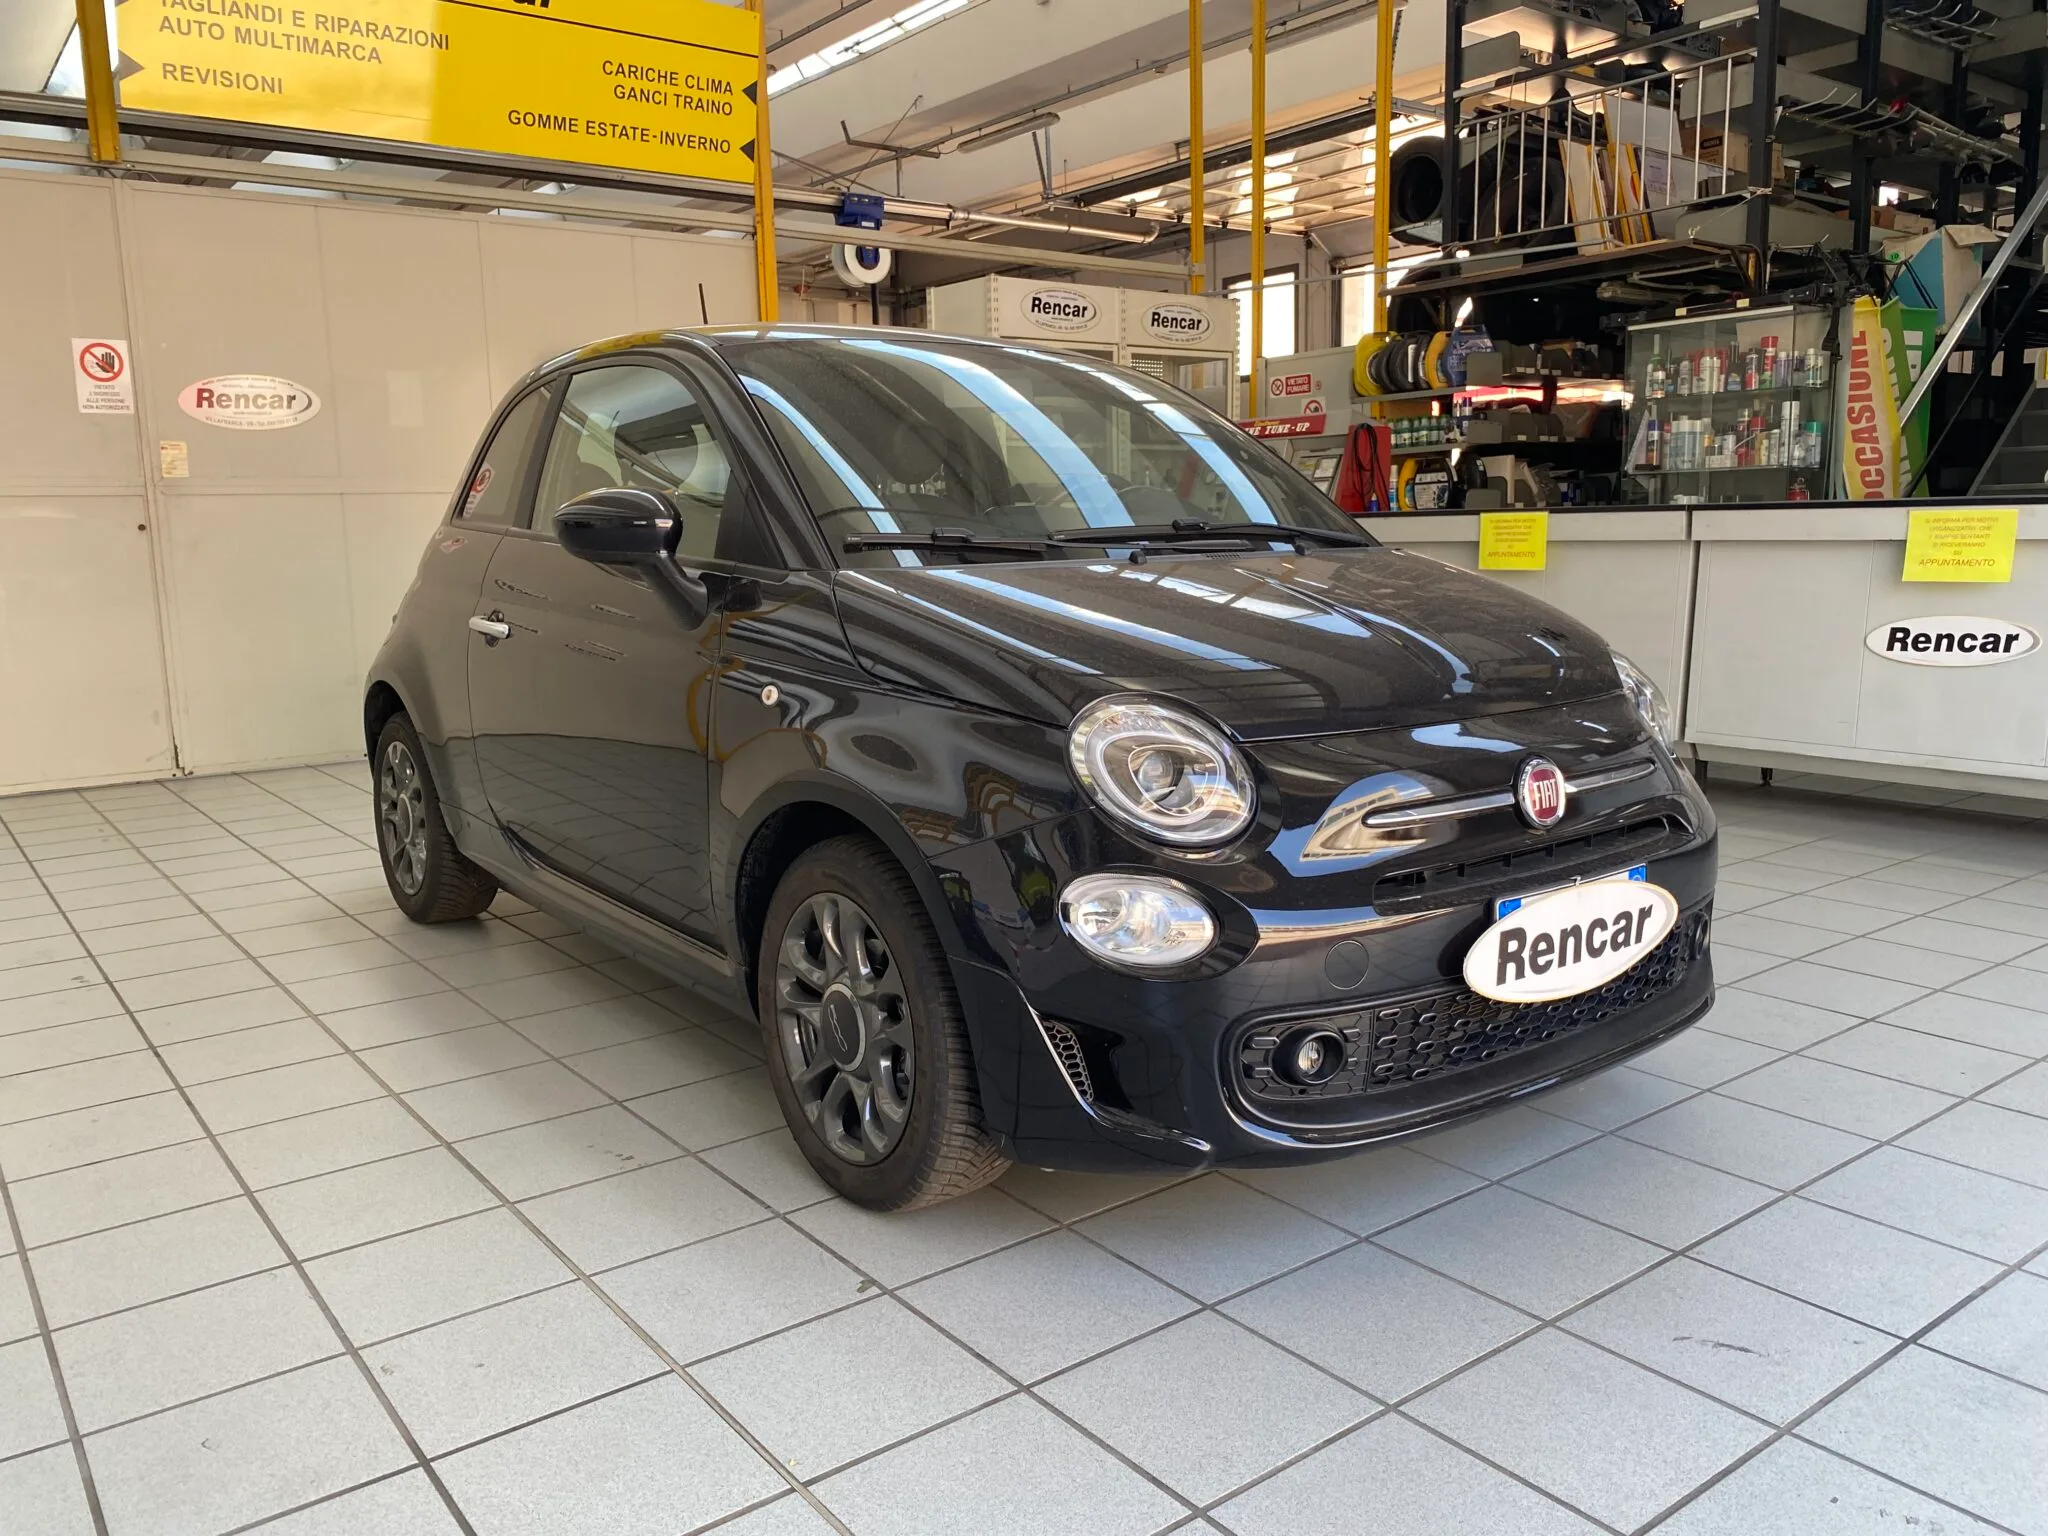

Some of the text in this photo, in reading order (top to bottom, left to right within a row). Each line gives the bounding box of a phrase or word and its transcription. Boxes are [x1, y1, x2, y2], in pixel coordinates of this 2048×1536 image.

[159, 15, 383, 64] AUTO MULTIMARCA
[292, 11, 306, 28] E
[314, 13, 449, 50] RIPARAZIONI
[161, 63, 283, 94] REVISIONI
[602, 60, 733, 96] CARICHE CLIMA
[613, 84, 733, 116] GANCI TRAINO
[508, 109, 731, 154] GOMME ESTATE-INVERNO
[1031, 296, 1088, 318] Rencar
[1151, 311, 1202, 331] Rencar
[1286, 384, 1310, 394] FUMARE
[1287, 376, 1309, 386] VIETATO
[196, 388, 296, 410] Rencar
[1918, 558, 1996, 567] APPUNTAMENTO
[1886, 627, 2020, 653] Rencar
[1533, 778, 1558, 811] FIAT
[1496, 904, 1653, 986] Rencar
